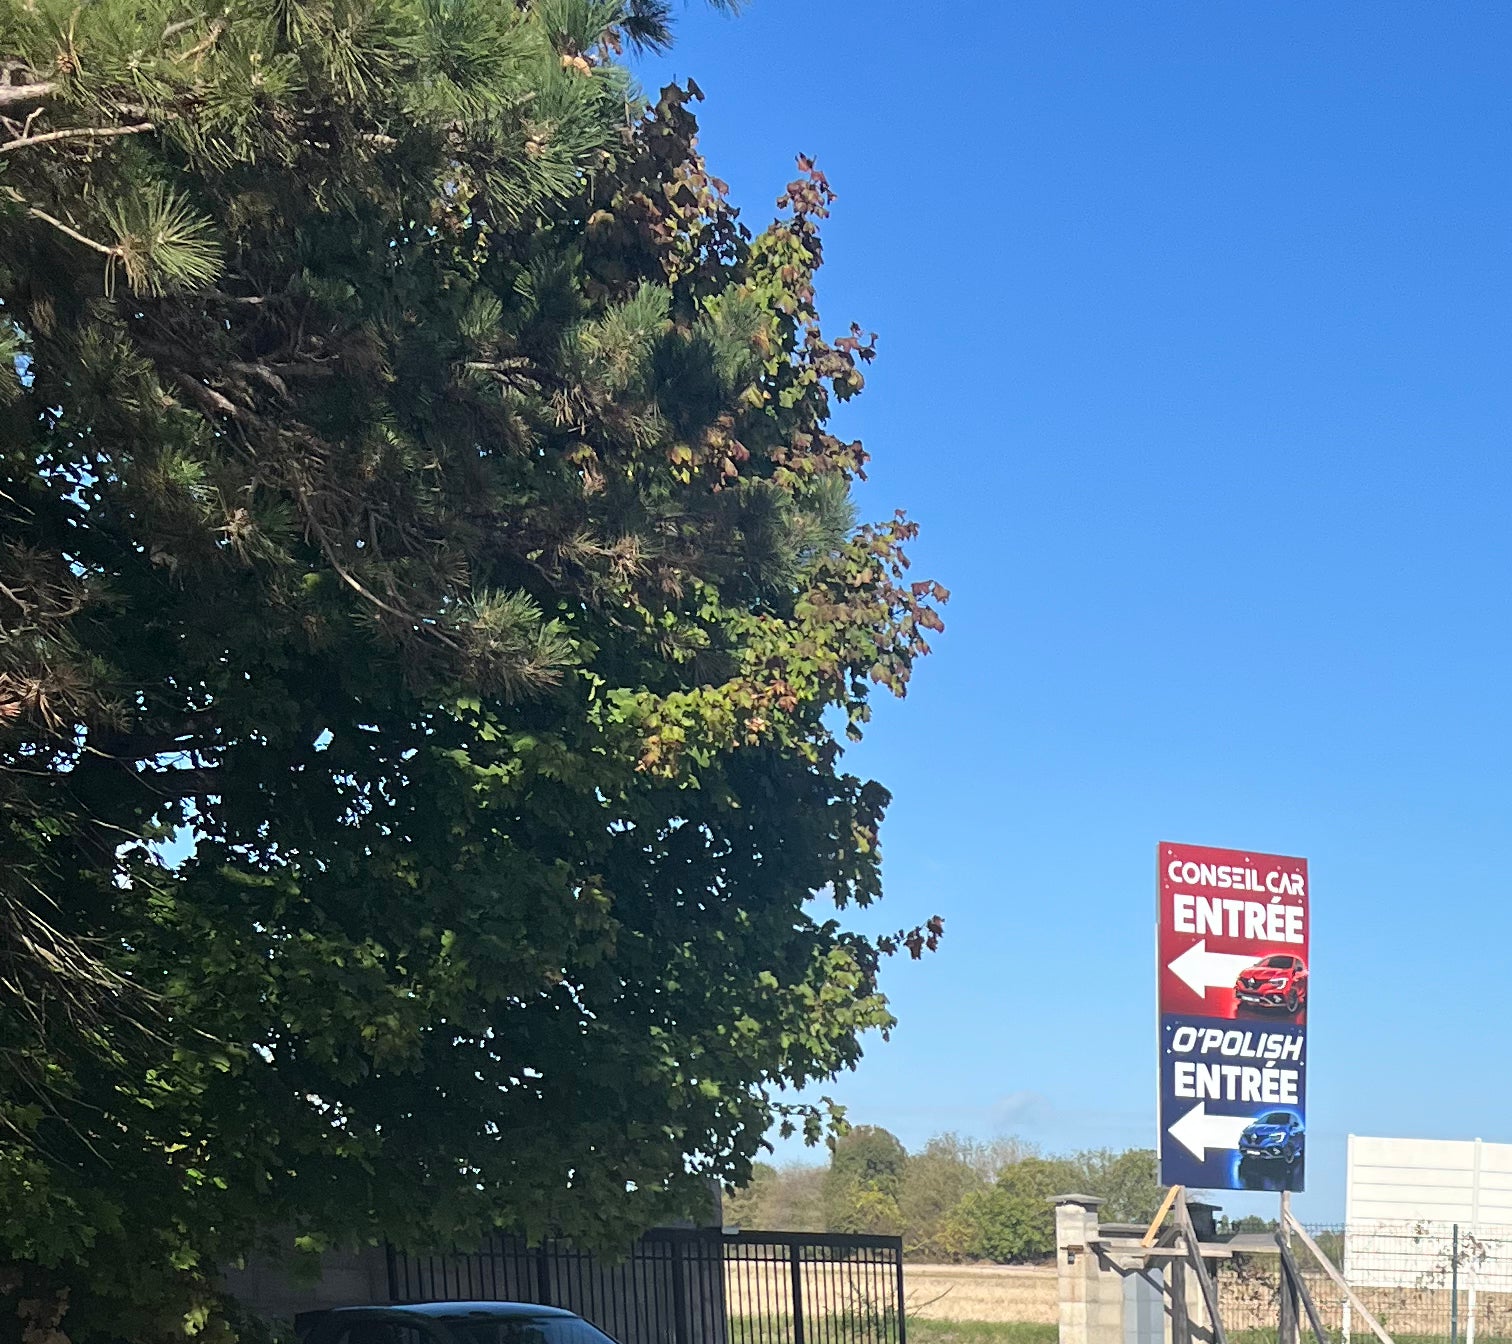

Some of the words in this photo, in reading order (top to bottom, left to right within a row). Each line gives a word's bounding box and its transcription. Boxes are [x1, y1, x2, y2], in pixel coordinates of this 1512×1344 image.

[1168, 861, 1265, 892] CONSEIL
[1265, 871, 1305, 896] CAR
[1173, 895, 1304, 944] ENTRÉE
[1172, 1026, 1303, 1061] O'POLISH
[1174, 1061, 1299, 1104] ENTRÉE
